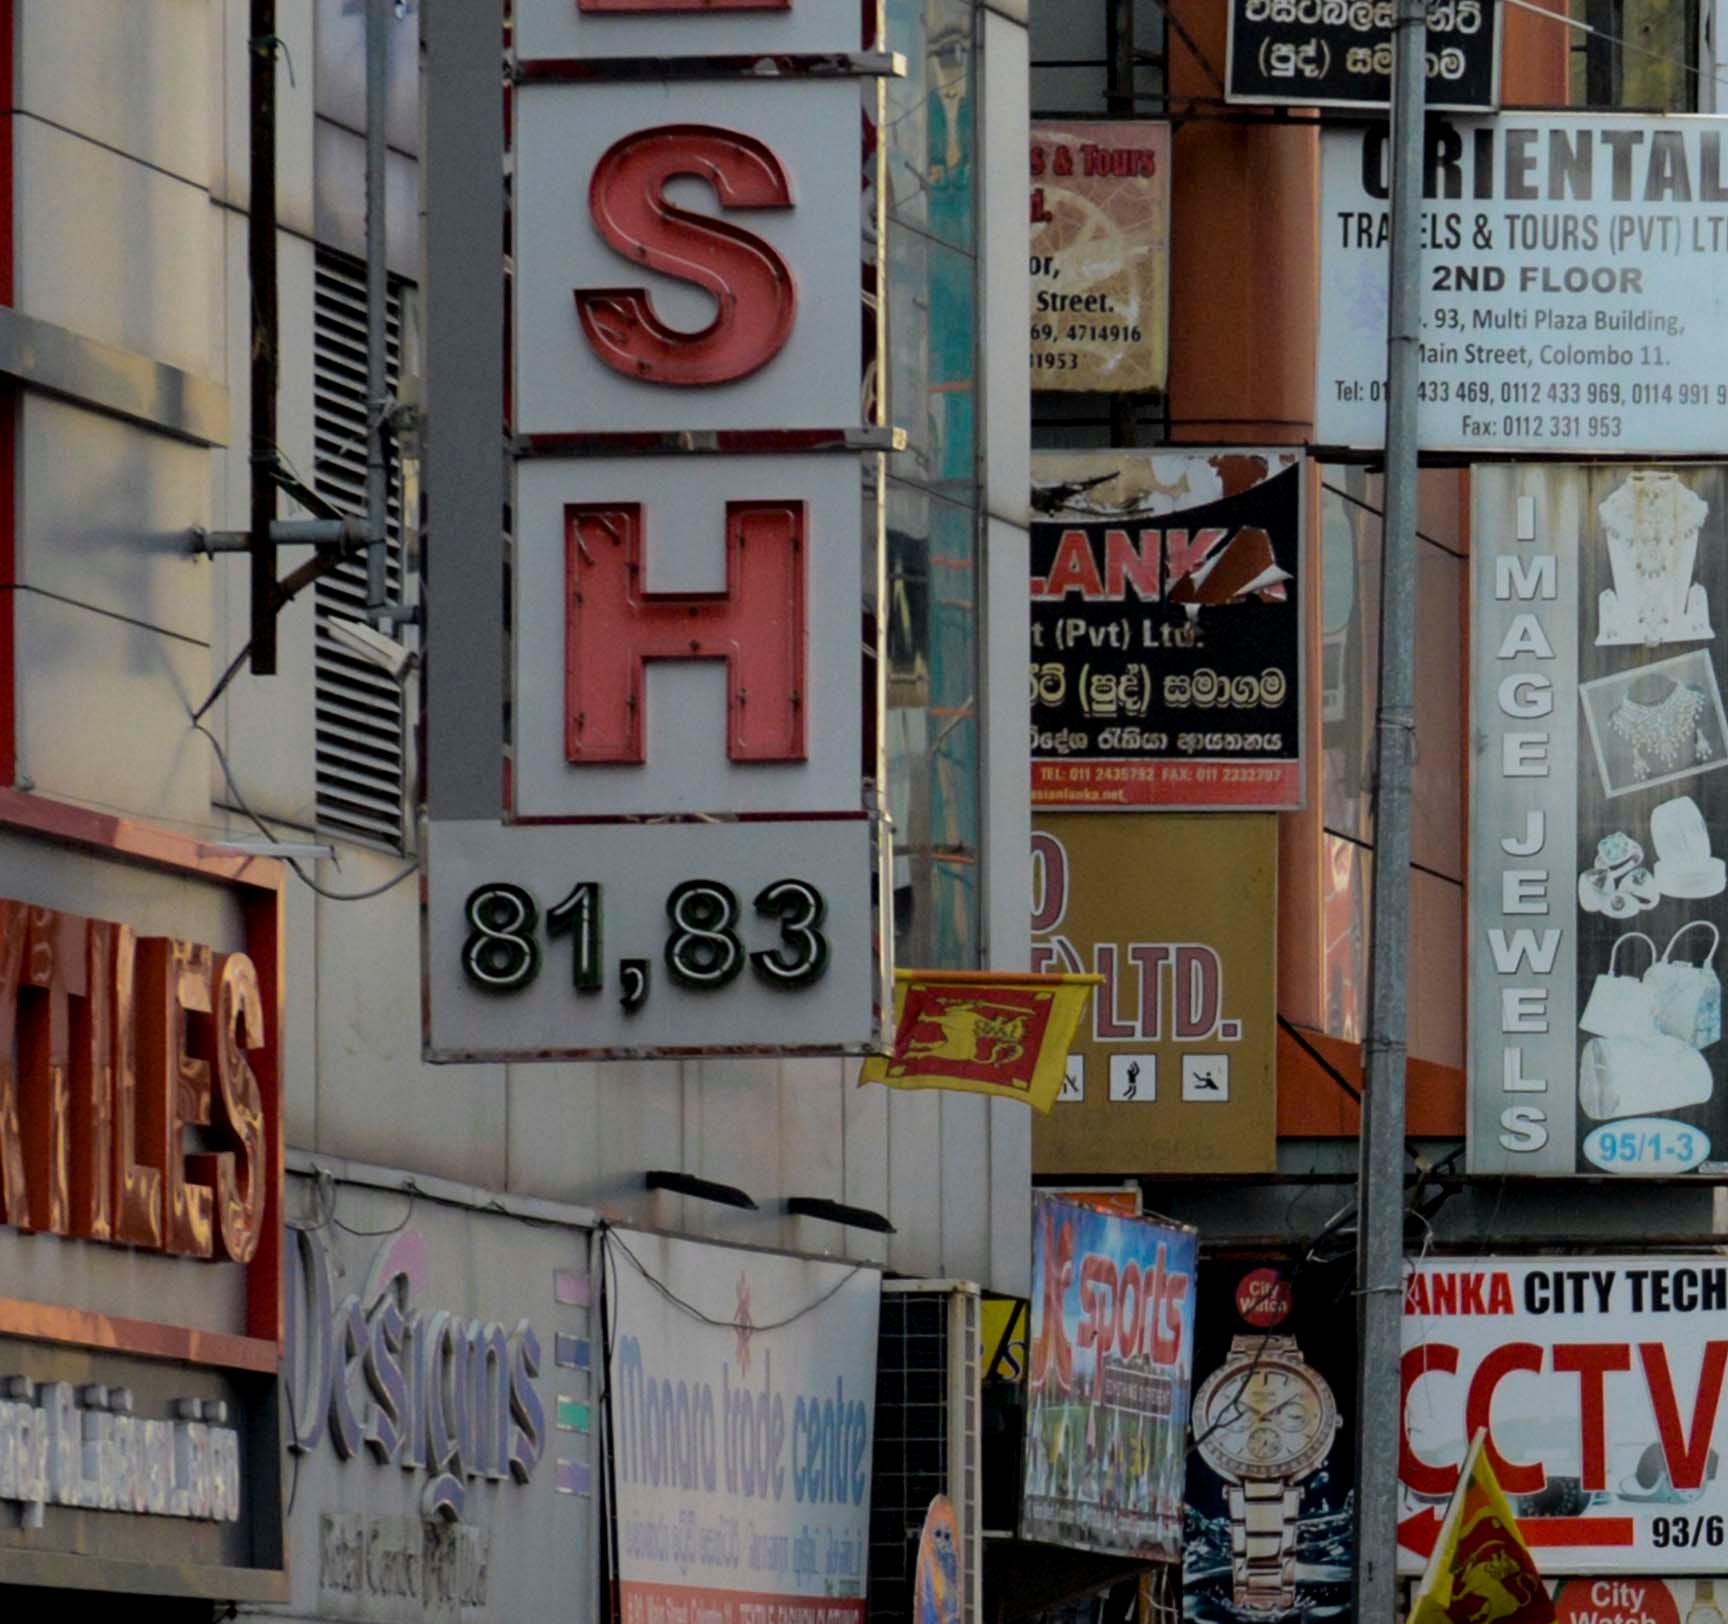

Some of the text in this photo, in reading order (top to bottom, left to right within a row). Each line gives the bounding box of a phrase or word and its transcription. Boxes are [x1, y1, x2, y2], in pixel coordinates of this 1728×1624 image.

[1338, 212, 1461, 250] TRAELS
[1473, 217, 1493, 249] &
[1506, 214, 1598, 252] TOURS
[1610, 215, 1681, 256] (PVT)
[1432, 266, 1643, 294] 2ND FLOOR
[1036, 290, 1115, 314] Street.
[1067, 324, 1142, 344] 4714916
[1435, 309, 1686, 336] 93, Multi Plaza Building,
[1465, 344, 1671, 369] Street, Colombo 11.
[1335, 380, 1365, 402] Tel:
[1456, 382, 1495, 406] 469,
[1500, 382, 1541, 404] 0112
[1547, 383, 1581, 404] 433
[1587, 383, 1626, 407] 969,
[1632, 383, 1673, 405] 0114
[1678, 384, 1709, 405] 991
[1462, 416, 1623, 438] Fax: 0112 331 953
[1056, 618, 1131, 650] (Pvt)
[1487, 497, 1561, 1153] IMAGE JEWELS
[460, 880, 827, 1010] 81,83
[1093, 942, 1242, 1043] LTD.
[1598, 1130, 1695, 1164] 95/1-3
[1524, 1267, 1727, 1314] CITY TECH
[1651, 1515, 1725, 1548] 93/6
[1591, 1581, 1645, 1612] City
